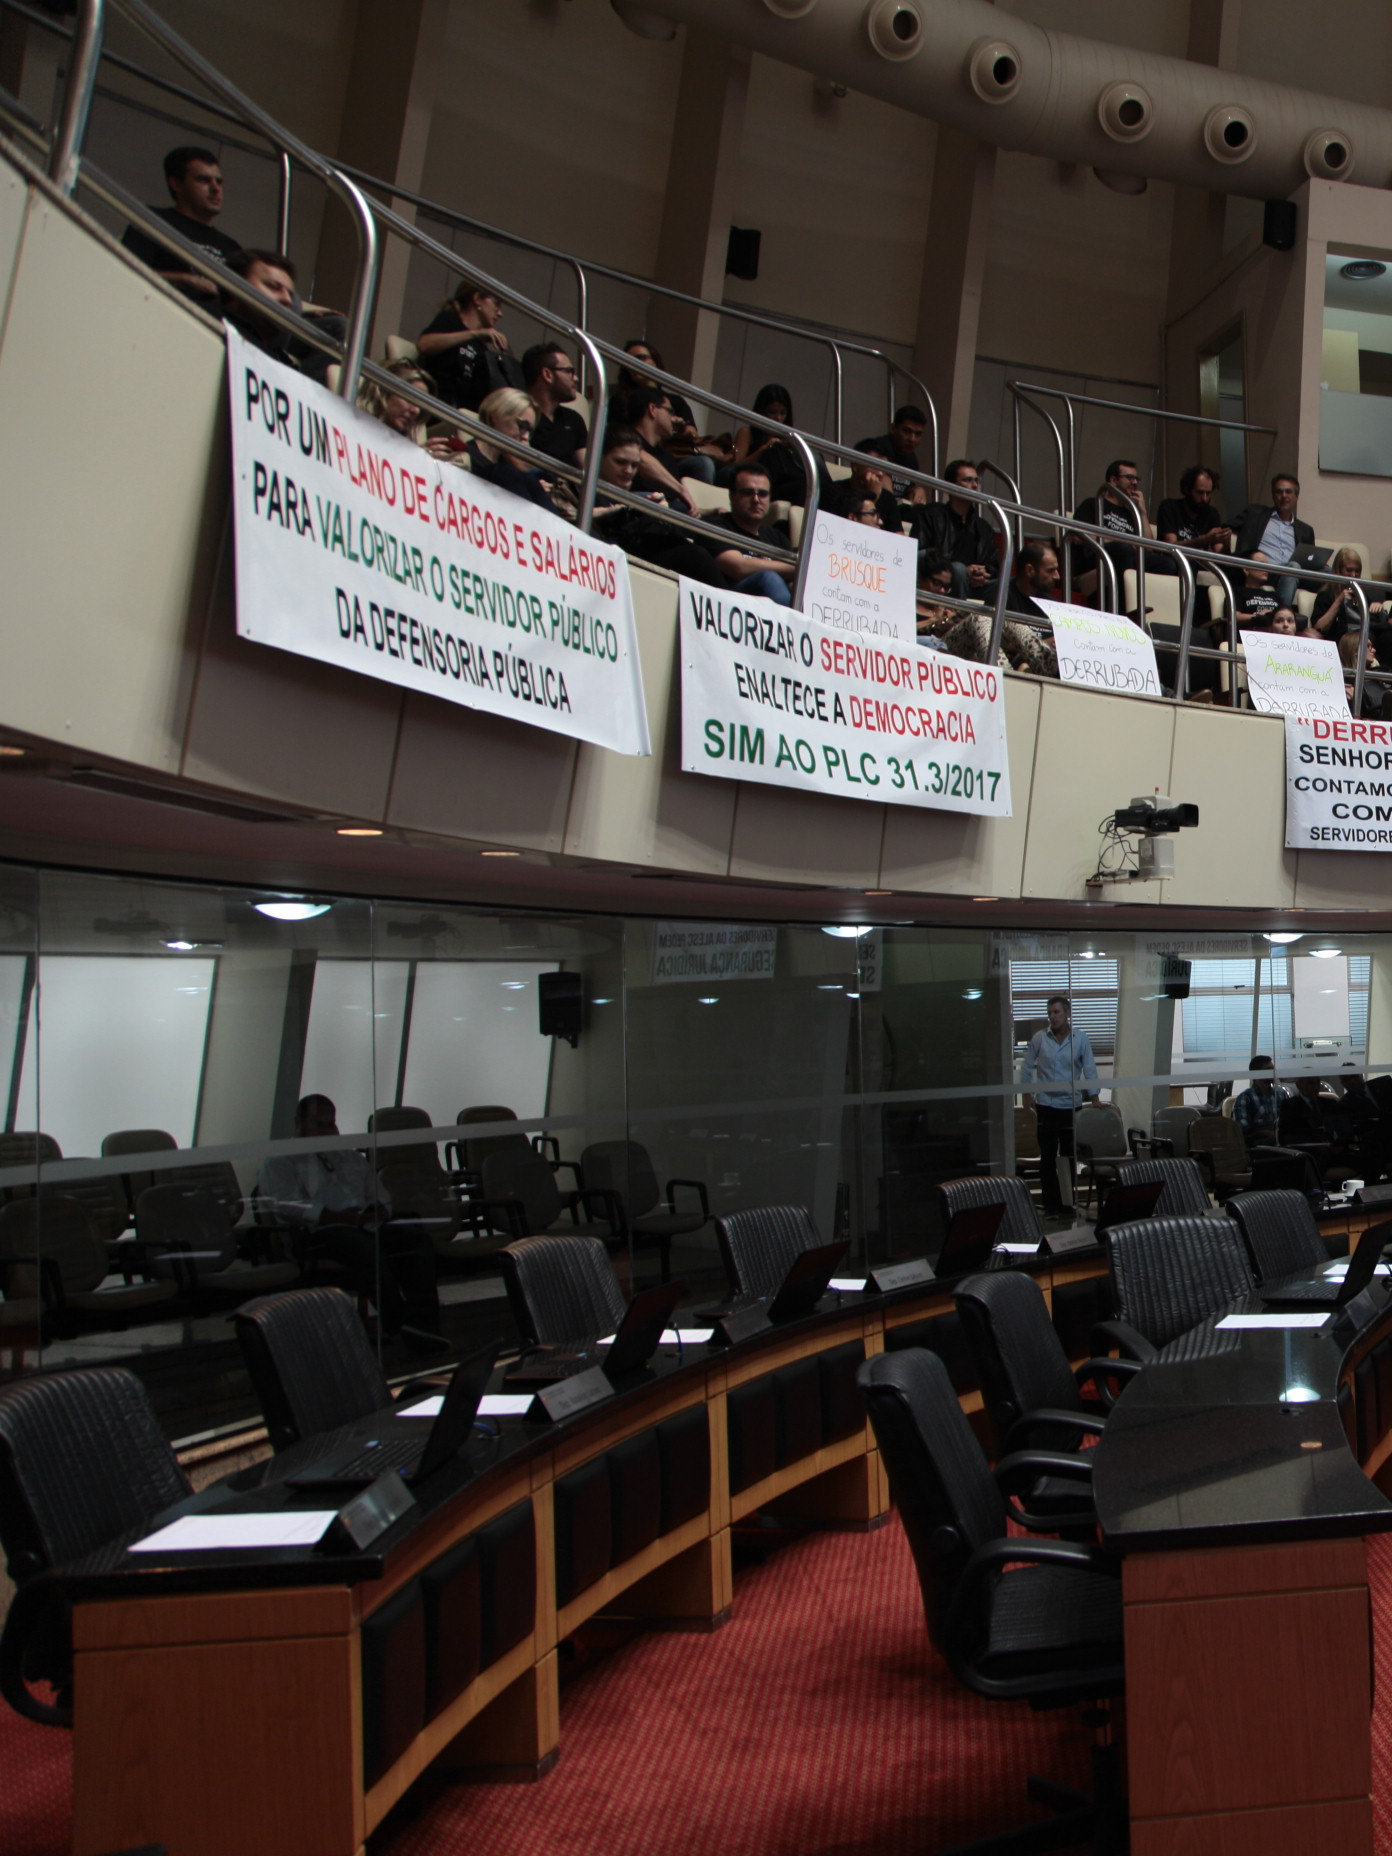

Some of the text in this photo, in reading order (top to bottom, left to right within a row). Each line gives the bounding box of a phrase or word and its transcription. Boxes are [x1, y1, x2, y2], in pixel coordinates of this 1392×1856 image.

[246, 367, 615, 600] POR UM PLANO DE CARGOS E SALÁRIOS
[254, 460, 618, 663] PARA VALORIZAR O SERVIDOR PÚBLICO
[827, 553, 888, 593] BRUSQUE
[893, 548, 902, 567] de
[854, 597, 870, 609] com
[873, 604, 880, 612] a
[335, 586, 572, 713] DA DEFENSORIA PÚBLICA
[690, 591, 997, 702] VALORIZAR O SERVIDOR PÚBLICO
[1060, 657, 1157, 694] DERRUBADA
[1321, 647, 1334, 659] de
[734, 661, 976, 745] ENALTECE A DEMOCRACIA
[1320, 689, 1329, 697] a
[704, 719, 1001, 802] SIM AO PLC 31.3/2017
